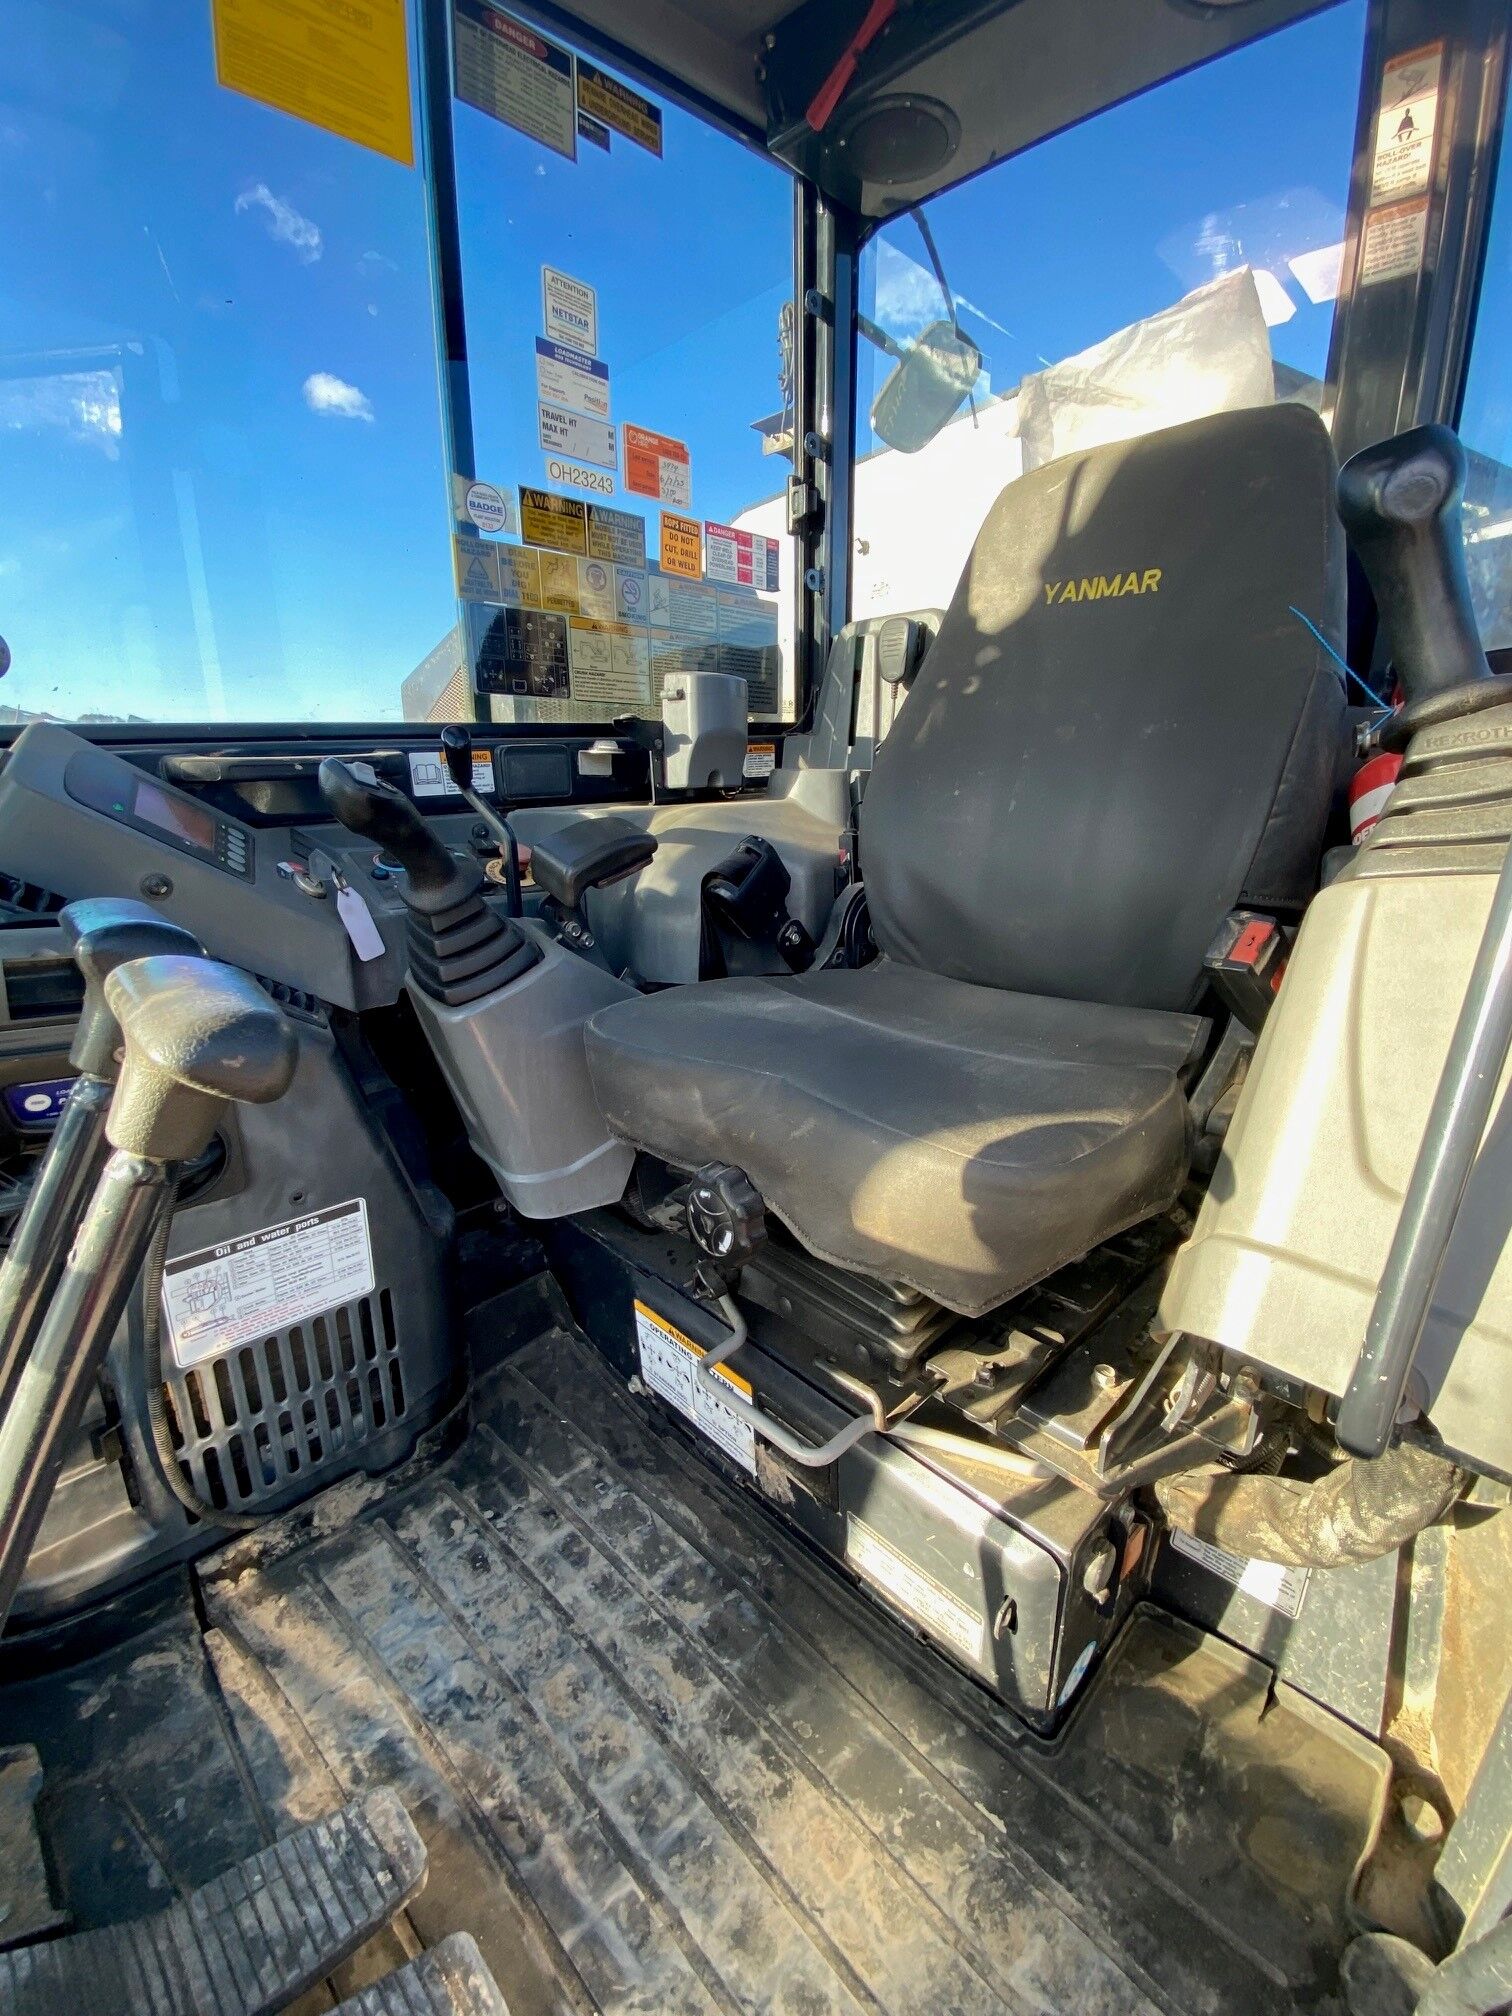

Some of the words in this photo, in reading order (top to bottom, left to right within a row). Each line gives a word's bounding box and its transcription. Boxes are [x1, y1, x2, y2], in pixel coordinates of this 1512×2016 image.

[494, 19, 536, 51] DANGER
[604, 78, 648, 115] WARNING
[551, 276, 589, 300] ATTENTION
[552, 305, 589, 329] NETSTAR
[554, 346, 592, 366] LOADMASTER
[584, 393, 608, 409] Position
[541, 408, 567, 425] TRAVEL
[568, 418, 578, 428] HT
[542, 421, 559, 434] MAX
[559, 428, 569, 437] HT
[607, 430, 614, 440] M
[608, 442, 614, 451] M
[637, 432, 659, 445] ORANGE
[550, 461, 614, 494] OH23243
[469, 501, 503, 513] BADGE
[533, 492, 583, 517] WARNING
[600, 509, 642, 530] WARNING
[680, 521, 699, 535] FITTED
[713, 526, 736, 539] DANGER
[669, 532, 679, 542] DO
[680, 535, 694, 547] NOT
[597, 549, 611, 558] THIS
[680, 547, 698, 560] DRILL
[501, 557, 536, 570] BEFORE
[667, 557, 676, 566] OR
[678, 560, 695, 571] WELD
[511, 569, 529, 579] YOU
[511, 580, 527, 589] DIG
[1044, 568, 1162, 605] YANMAR
[618, 611, 646, 621] SMOKING
[215, 1245, 231, 1258] Oil
[236, 1237, 256, 1251] and
[261, 1226, 291, 1243] water
[295, 1216, 320, 1232] ports
[649, 1322, 693, 1361] OPERATING
[675, 1330, 705, 1357] WARNIN
